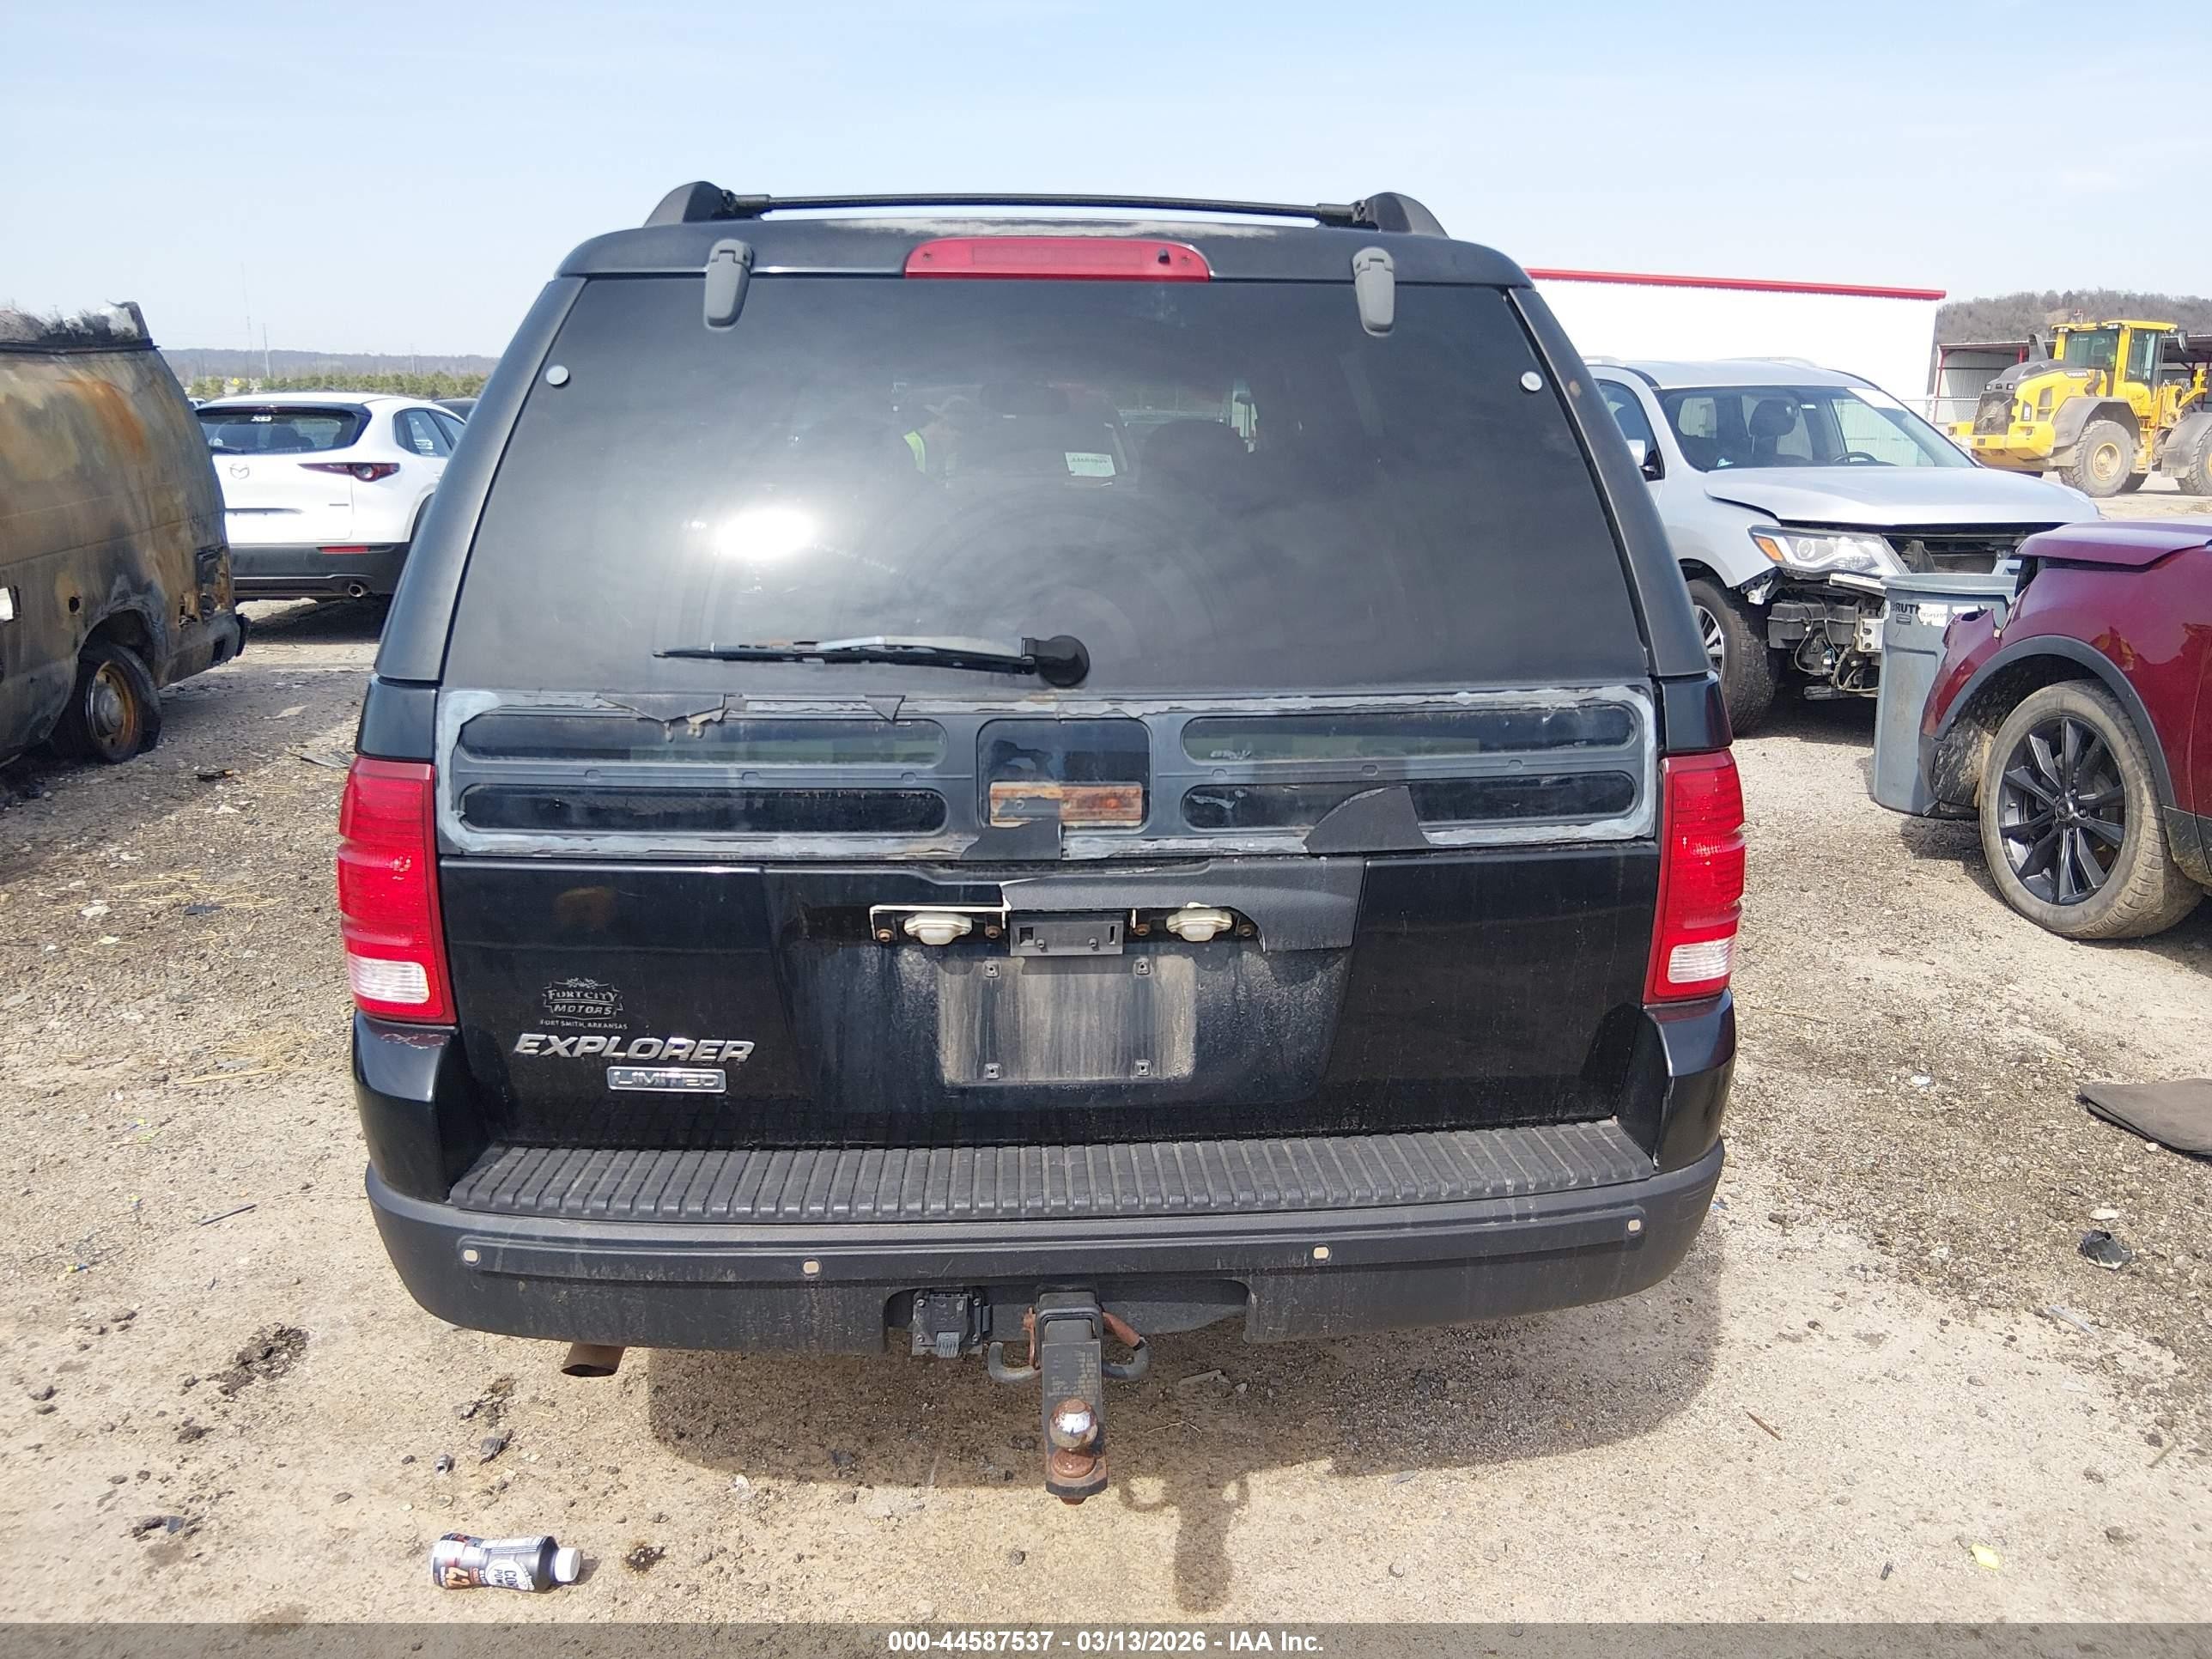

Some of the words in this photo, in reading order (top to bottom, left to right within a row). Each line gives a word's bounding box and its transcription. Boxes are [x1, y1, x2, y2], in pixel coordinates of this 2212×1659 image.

[554, 1004, 613, 1015] MOTORS
[587, 1022, 629, 1030] ARKANSAS
[514, 1033, 756, 1063] EXPLORER
[612, 1070, 720, 1088] LIMITED
